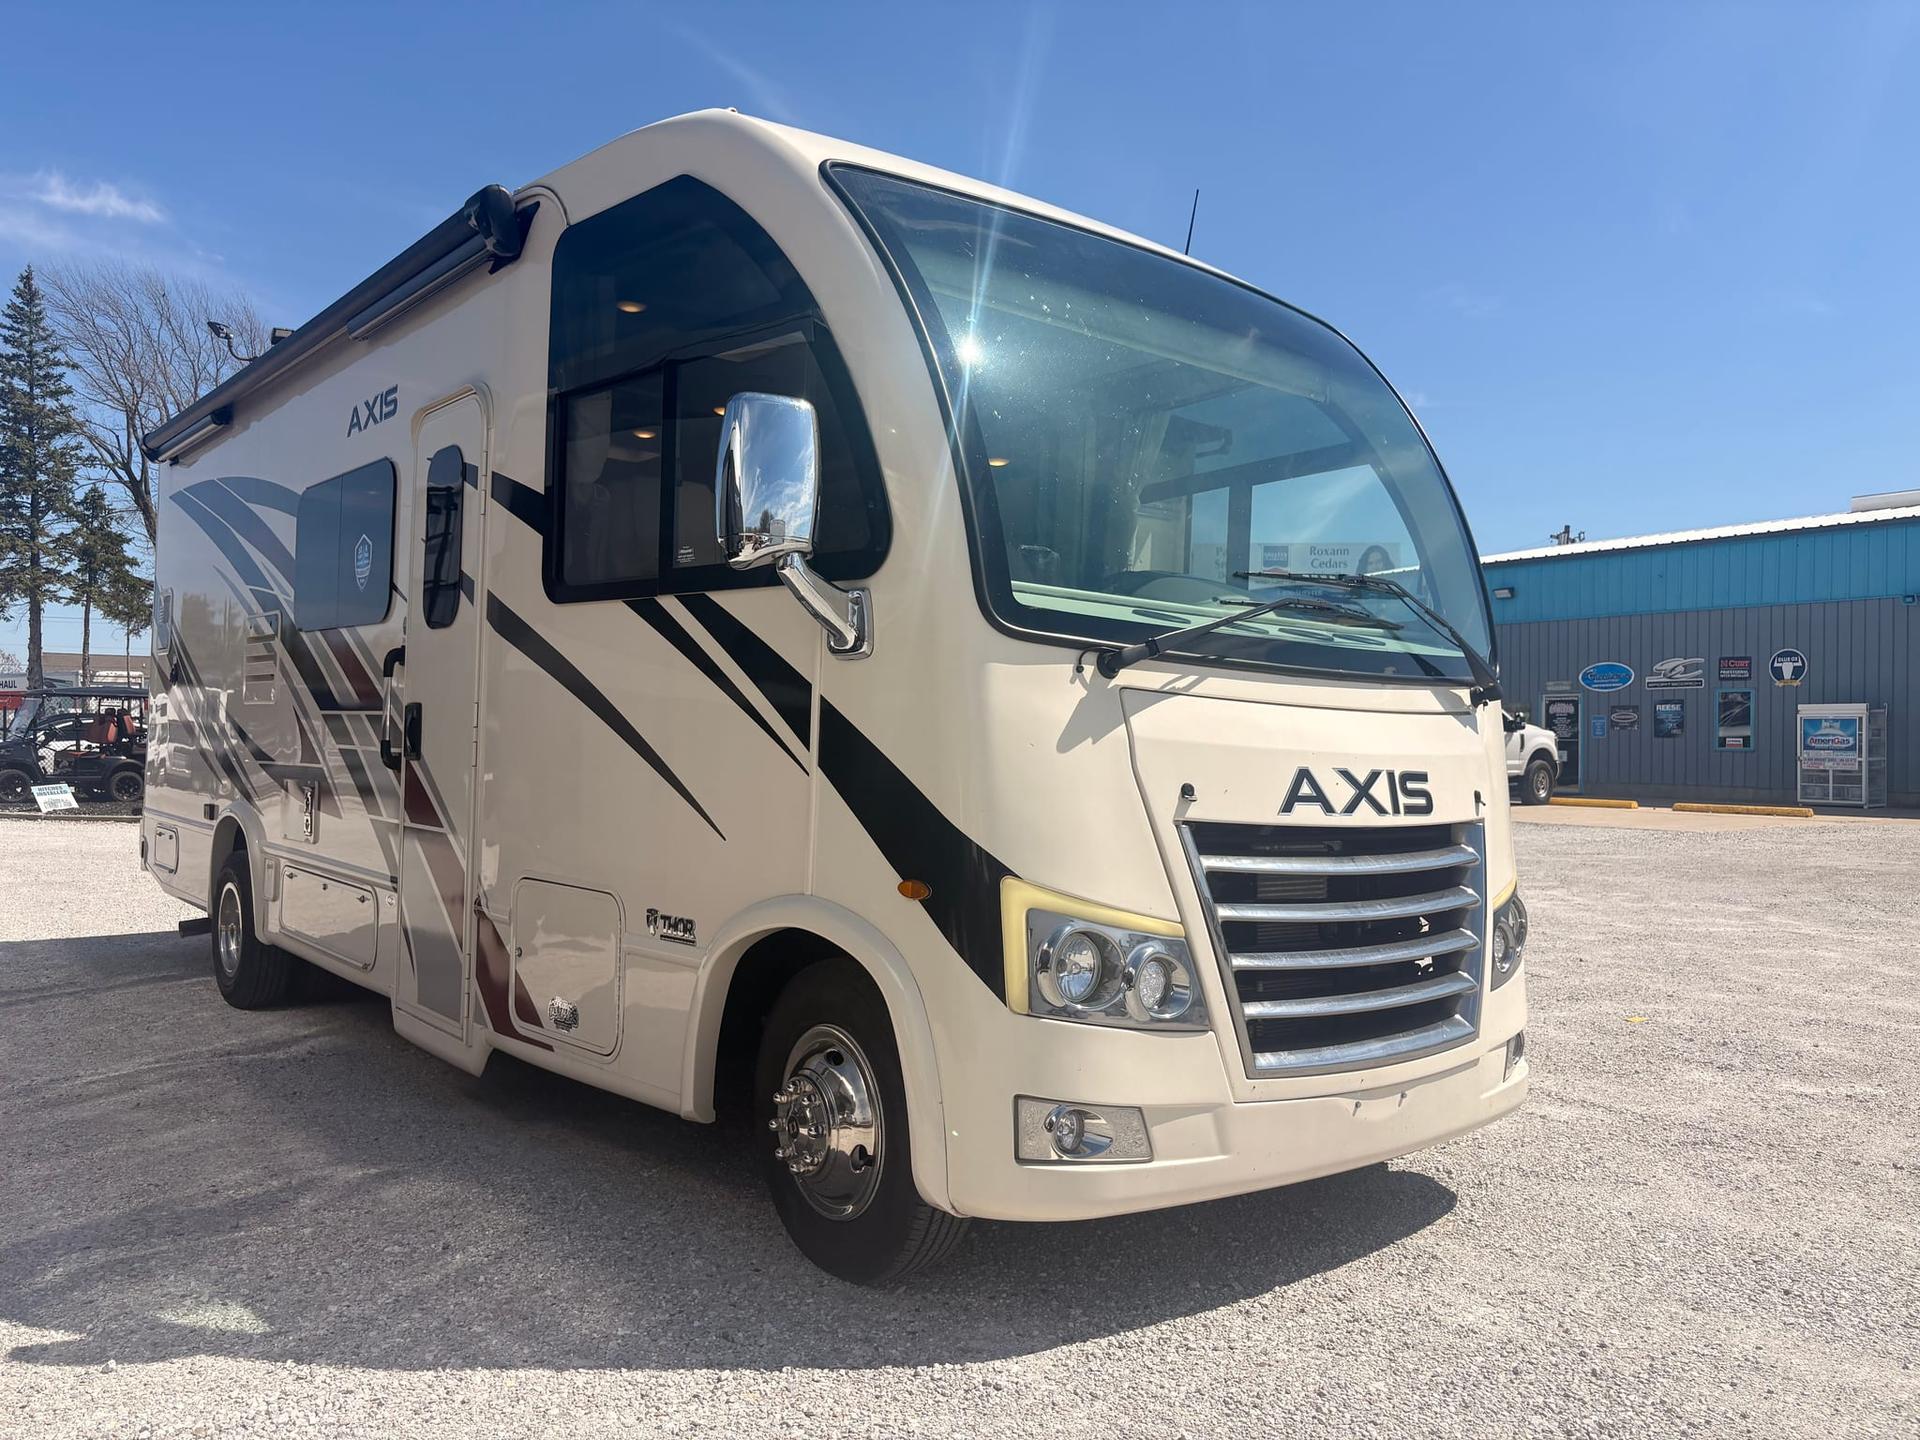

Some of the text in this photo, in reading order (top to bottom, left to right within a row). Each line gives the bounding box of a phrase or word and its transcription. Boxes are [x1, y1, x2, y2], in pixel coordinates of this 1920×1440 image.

[347, 384, 399, 438] AXIS
[1309, 545, 1350, 556] Roxann
[1310, 558, 1348, 569] Cedars
[1809, 736, 1850, 745] AmeriGas
[1277, 766, 1433, 816] AXIS
[660, 914, 696, 940] THOR
